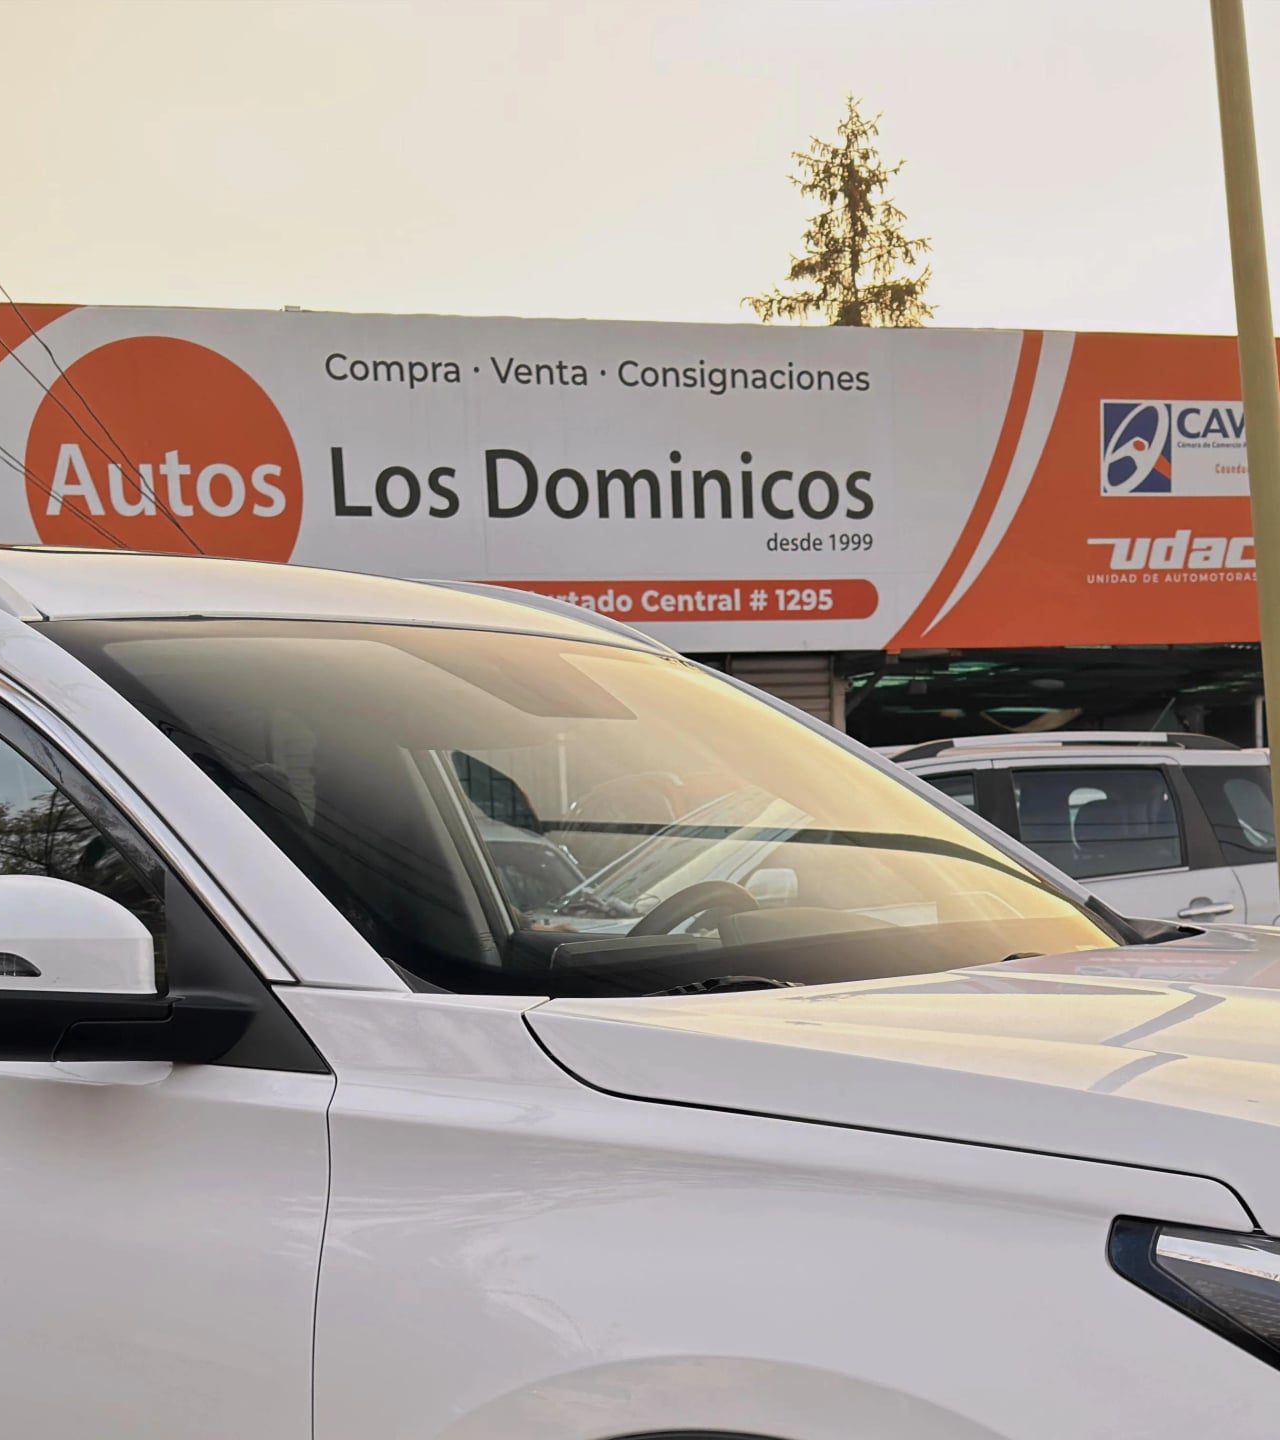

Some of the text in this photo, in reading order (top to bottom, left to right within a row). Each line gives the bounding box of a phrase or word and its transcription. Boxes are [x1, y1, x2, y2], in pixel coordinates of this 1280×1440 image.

[325, 353, 870, 396] Compra Venta Consignaciones
[45, 443, 287, 518] Autos
[330, 446, 874, 521] Los Dominicos
[766, 532, 874, 552] desde 1999
[1087, 574, 1138, 584] UNIDAD
[1142, 573, 1160, 583] DE
[640, 588, 741, 613] Central
[775, 588, 834, 611] 1295
